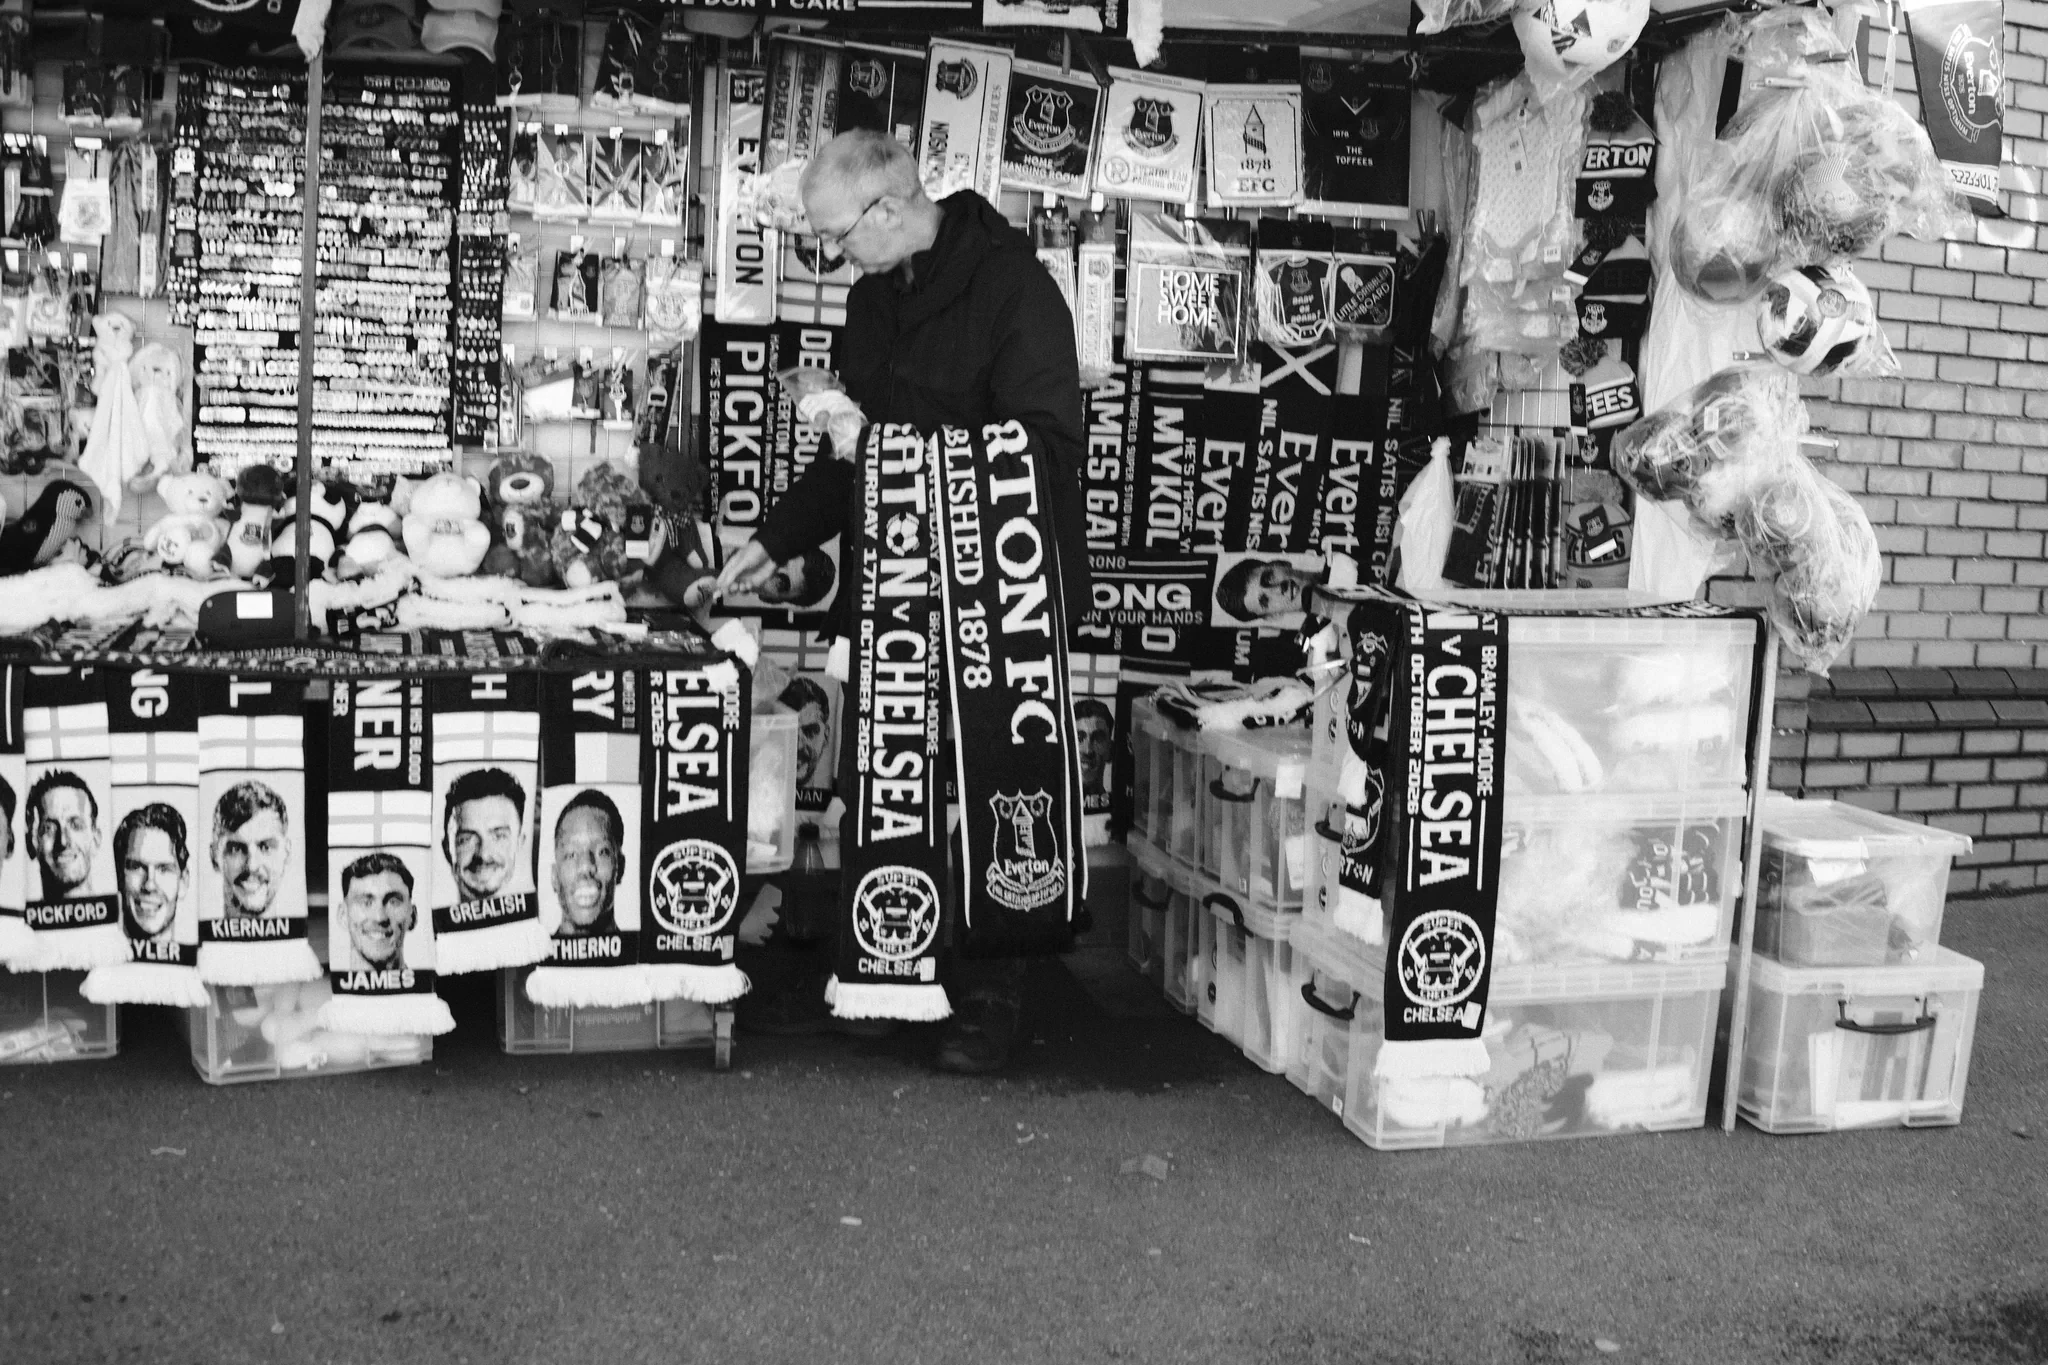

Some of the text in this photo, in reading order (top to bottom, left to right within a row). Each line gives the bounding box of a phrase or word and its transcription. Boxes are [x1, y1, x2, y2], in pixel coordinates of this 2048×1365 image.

[703, 0, 776, 9] DONT
[789, 0, 856, 11] CARE
[1963, 51, 1976, 115] Everton
[1947, 98, 1969, 136] OPTIMUM
[1023, 153, 1053, 168] HOME
[1335, 155, 1374, 167] TOFFEES
[1345, 145, 1363, 156] THE
[1585, 145, 1654, 169] ERTON
[1048, 170, 1080, 185] ROOM
[1240, 158, 1272, 174] 1878
[1236, 177, 1276, 193] EFC
[1159, 270, 1219, 293] HOME
[1159, 287, 1219, 309] SWEET
[1292, 294, 1314, 306] BABY
[1299, 304, 1311, 314] ON
[1336, 296, 1358, 321] LITTLE
[1157, 304, 1219, 328] HOME
[709, 390, 720, 456] ENGLAND
[1386, 398, 1402, 431] NIL
[723, 340, 766, 532] PICKFO
[773, 384, 792, 493] VERTON AND
[1124, 445, 1136, 482] SUPER
[1145, 405, 1184, 548] MYKOL
[1246, 398, 1278, 551] NIL SATIS NIS
[1379, 437, 1399, 499] SATIS
[865, 422, 881, 541] SATURDAY
[1085, 488, 1119, 550] GA
[1374, 504, 1392, 544] NISI
[942, 427, 993, 689] BLISHED 1878
[861, 547, 878, 612] 17TH
[929, 570, 941, 600] AT
[892, 601, 911, 622] v
[1109, 611, 1147, 624] YOUR
[1151, 611, 1204, 625] HANDS
[1441, 633, 1463, 657] v
[859, 618, 874, 714] OCTOBER
[925, 610, 941, 756] BRAMLEY-MOORE
[1005, 654, 1058, 744] FC
[1409, 653, 1425, 755] OCTOBER
[353, 679, 403, 772] NER
[870, 629, 927, 842] CHELSEA
[1476, 644, 1498, 797] BRAMLEY-MOORE
[666, 669, 720, 817] ELSEA
[1419, 664, 1478, 888] CHELSEA
[1003, 857, 1050, 876] Everton
[26, 901, 108, 926] PICKFORD
[449, 893, 527, 924] GREALISH
[210, 917, 291, 938] KIERNAN
[656, 934, 723, 951] CHELSEA
[553, 936, 622, 961] THIERNO
[339, 969, 416, 991] JAMES
[857, 956, 921, 977] CHELSEA
[1403, 1006, 1465, 1024] CHELSEA
